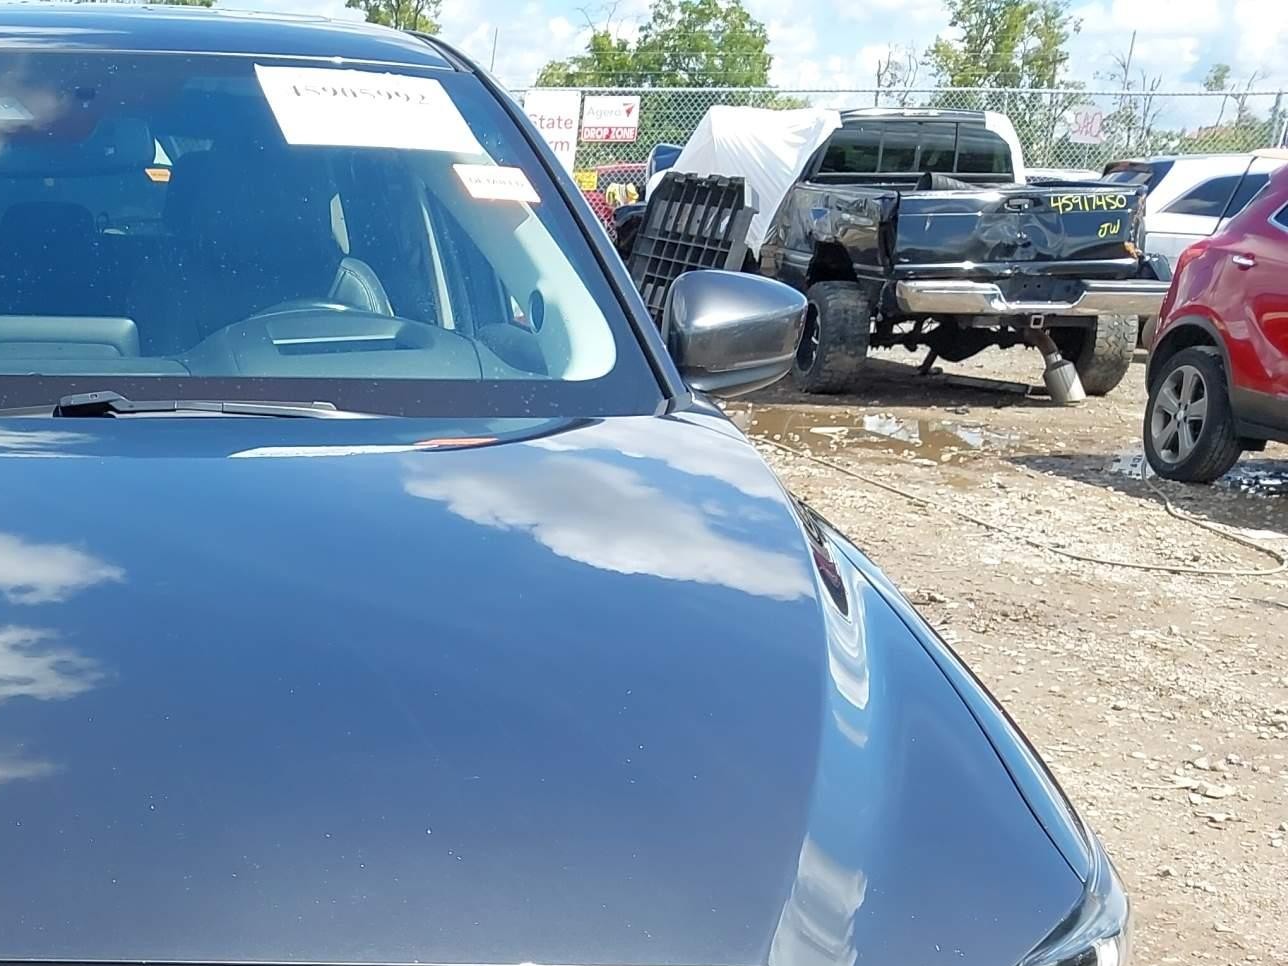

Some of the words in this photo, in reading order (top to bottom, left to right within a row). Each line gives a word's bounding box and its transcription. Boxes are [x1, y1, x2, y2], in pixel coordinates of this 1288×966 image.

[583, 127, 610, 140] DROP
[608, 127, 636, 140] ZONE
[1050, 194, 1127, 215] 45917450
[1098, 219, 1120, 238] JW
